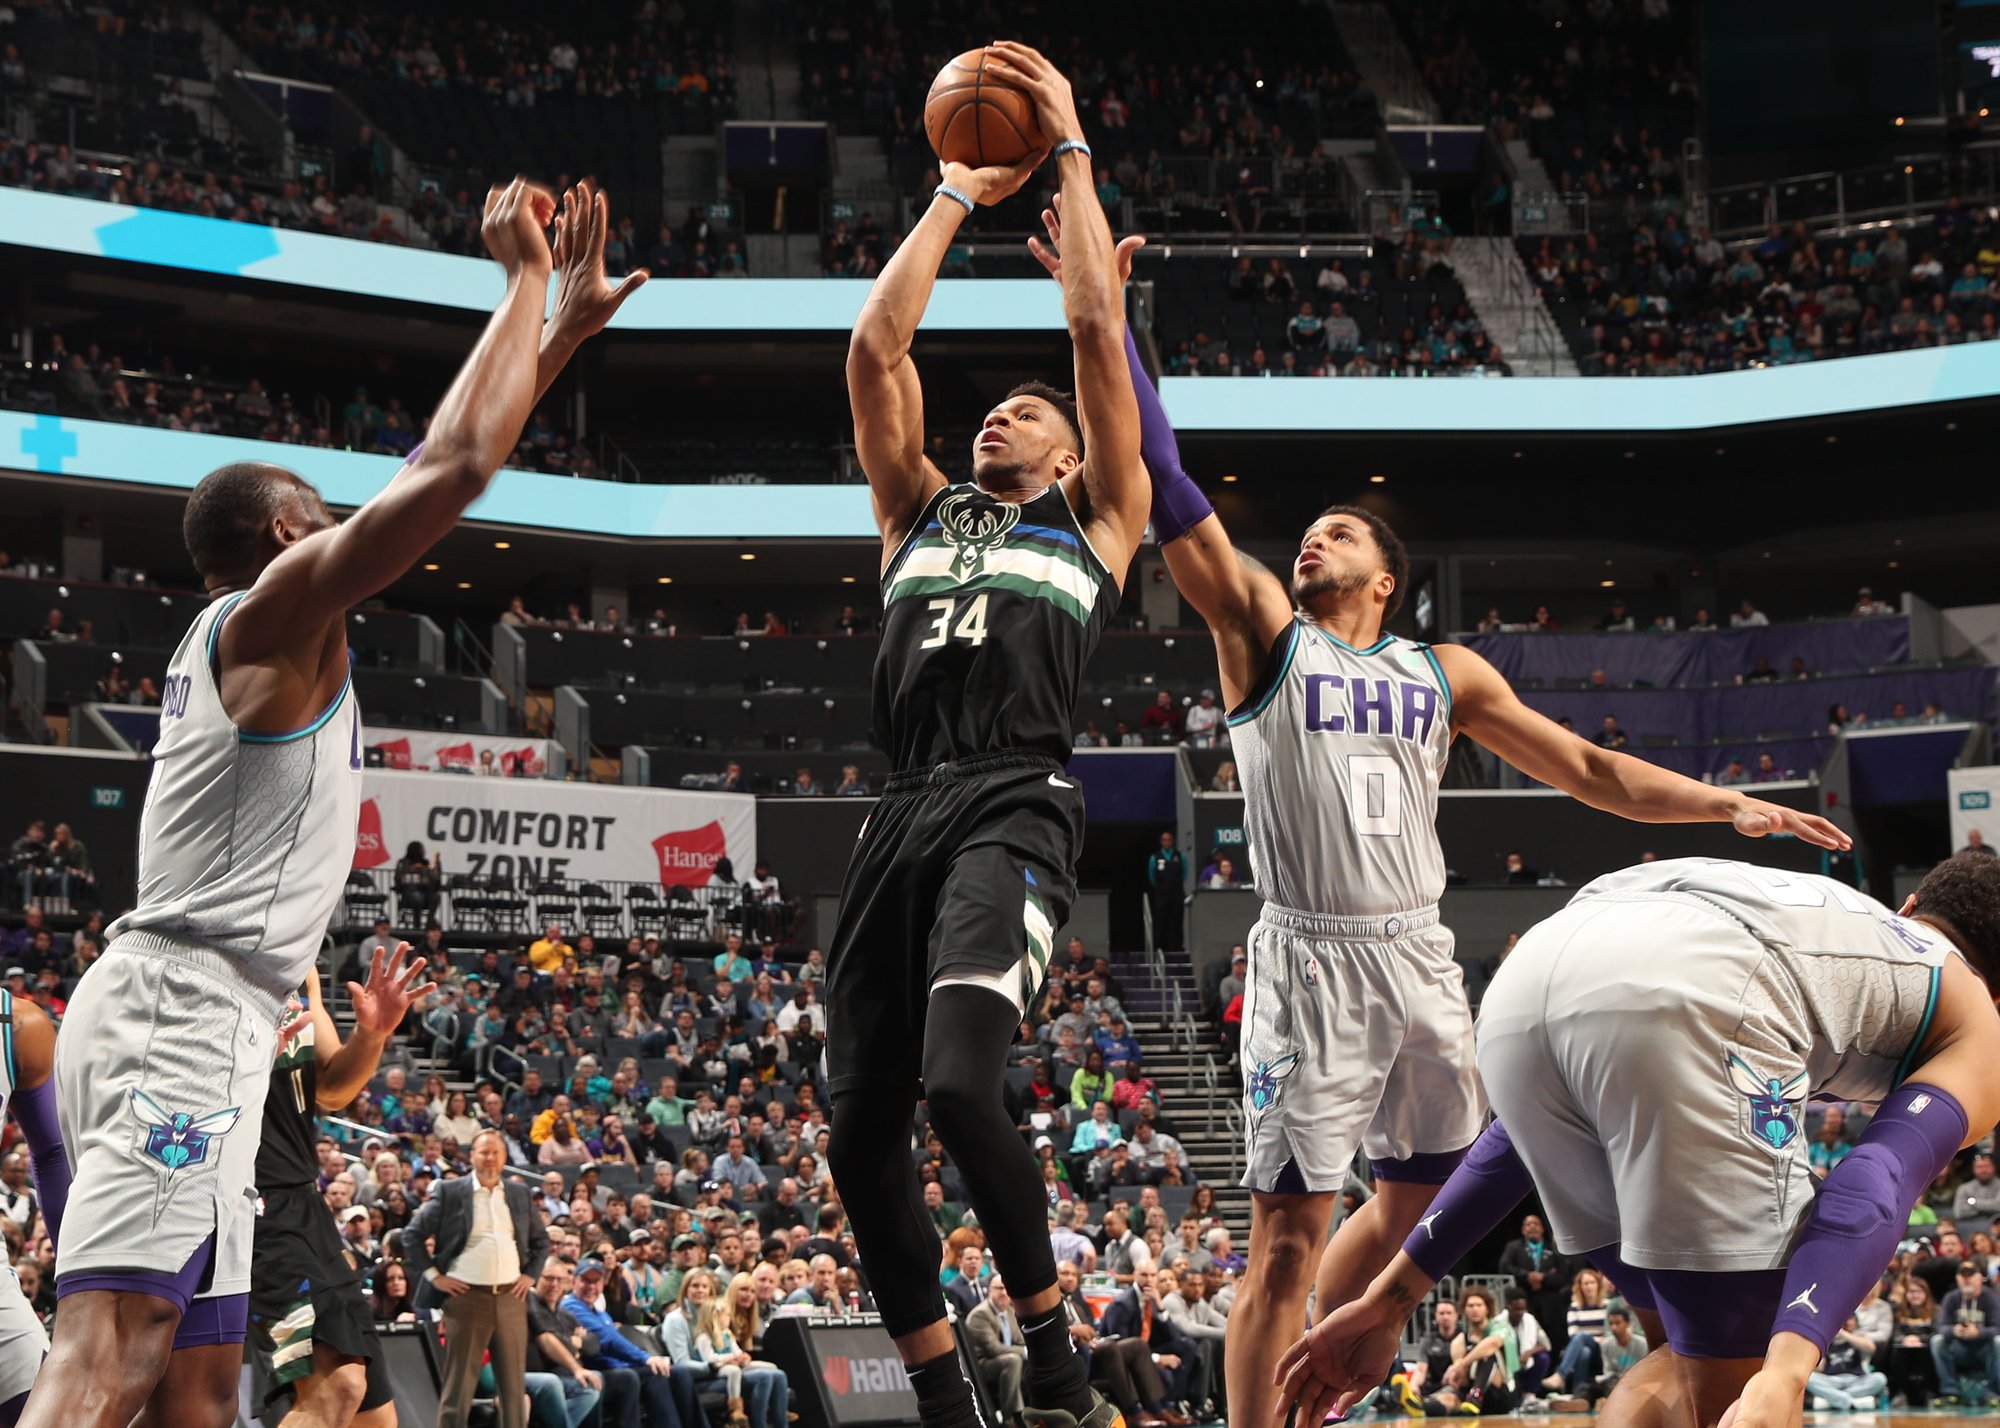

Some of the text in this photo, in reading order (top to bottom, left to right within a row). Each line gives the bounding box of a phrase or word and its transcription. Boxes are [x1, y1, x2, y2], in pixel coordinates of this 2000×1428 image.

[920, 592, 990, 650] 34
[1303, 673, 1439, 748] CHA
[95, 788, 121, 806] 107
[1347, 755, 1402, 837] 0
[427, 805, 616, 851] COMFORT
[1217, 828, 1242, 844] 108
[466, 852, 571, 891] ZONE
[290, 1067, 306, 1114] 11
